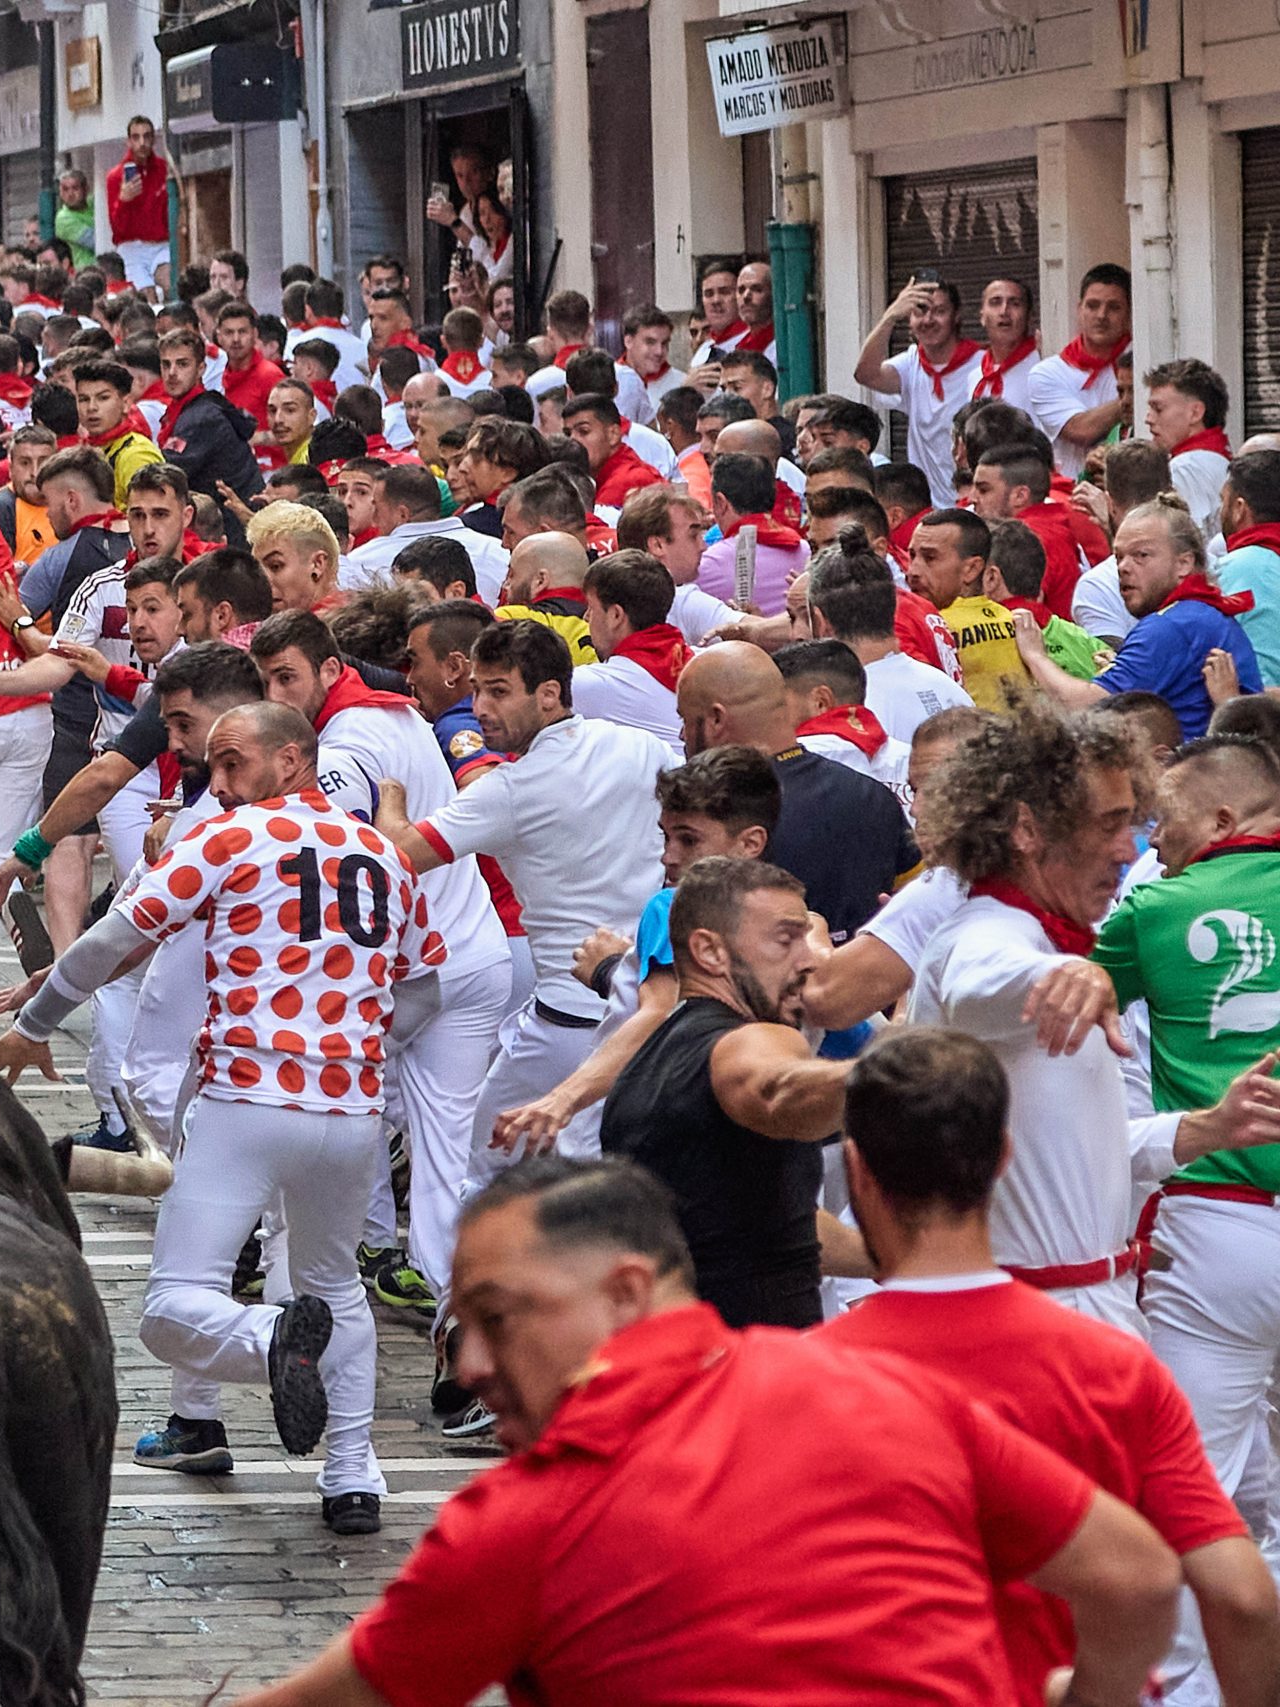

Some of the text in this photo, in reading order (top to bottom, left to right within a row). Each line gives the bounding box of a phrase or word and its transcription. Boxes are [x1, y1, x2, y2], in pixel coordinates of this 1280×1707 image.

[718, 36, 830, 87] AMADO MENDOZA
[724, 79, 835, 122] MARCOS Y MOLDURAS
[951, 622, 1007, 649] DANIEL
[281, 846, 389, 949] 10
[1188, 909, 1280, 1039] 2
